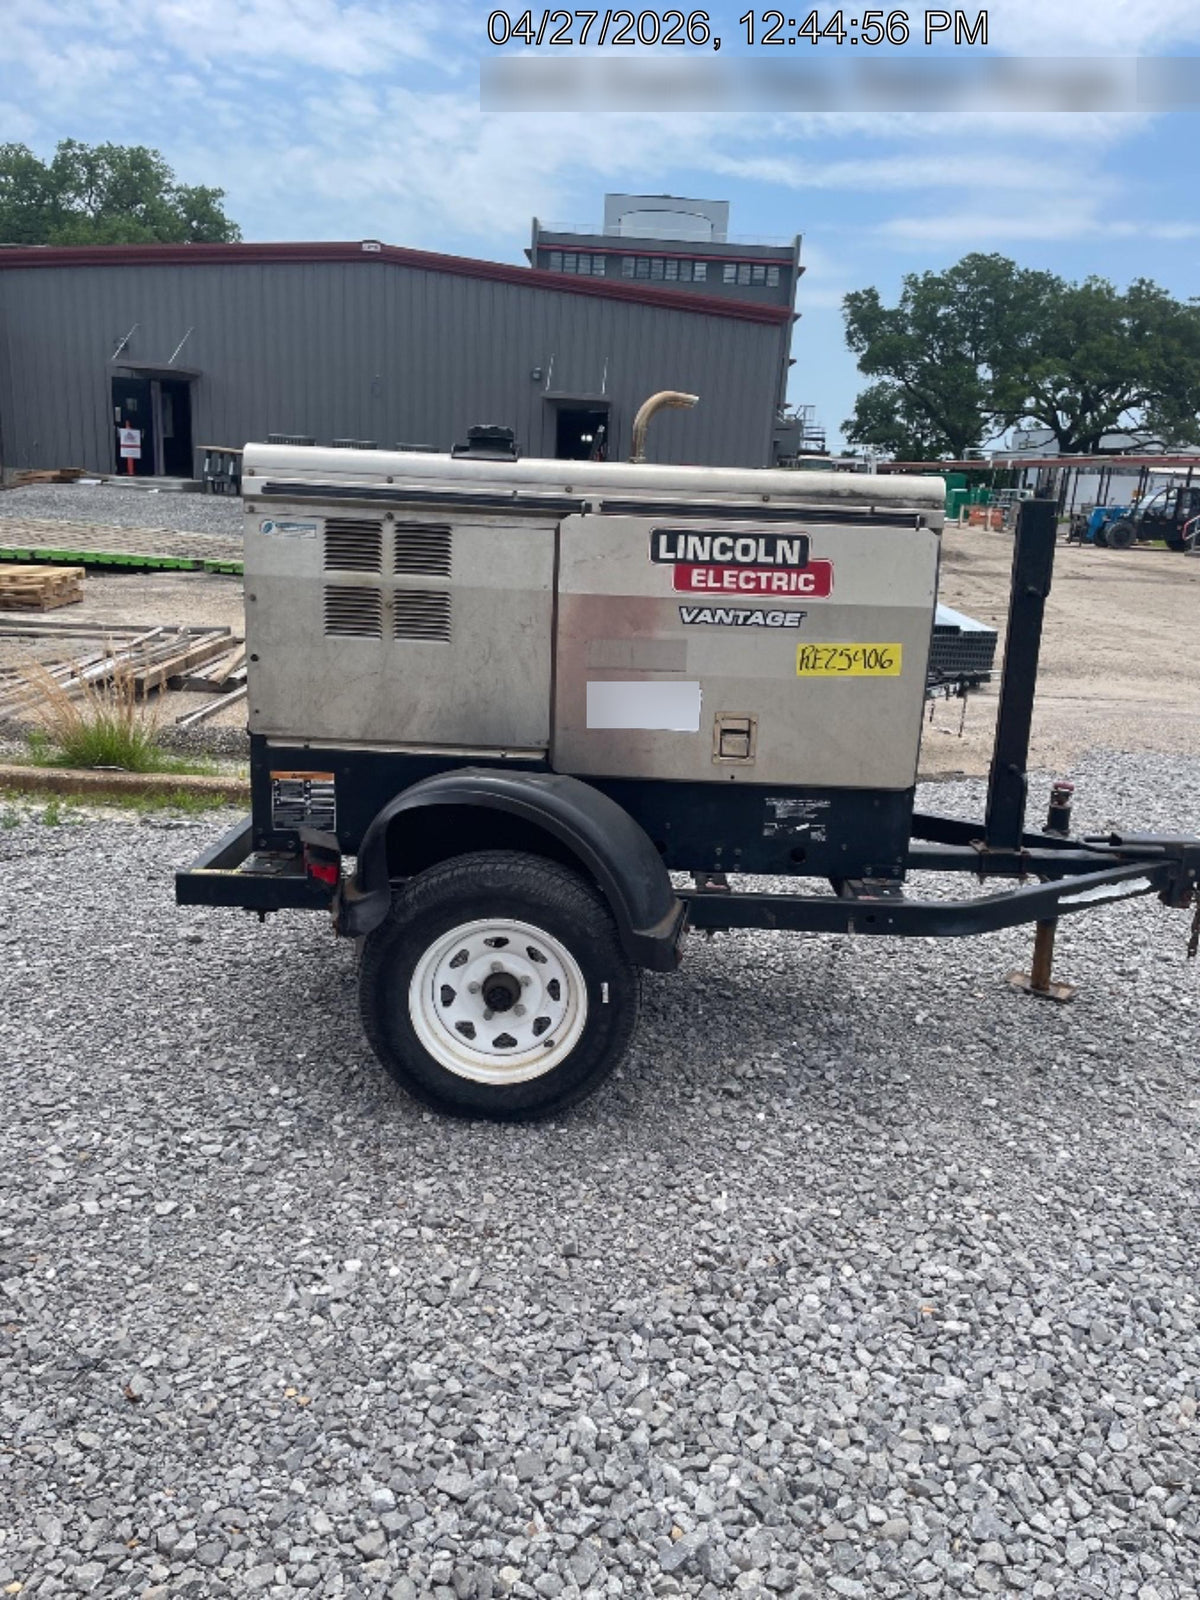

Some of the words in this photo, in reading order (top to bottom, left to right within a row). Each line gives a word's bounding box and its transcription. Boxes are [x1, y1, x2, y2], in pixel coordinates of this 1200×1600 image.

[658, 534, 801, 565] LINCOLN
[691, 568, 815, 591] ELECTRIC
[679, 606, 805, 628] VANTAGE
